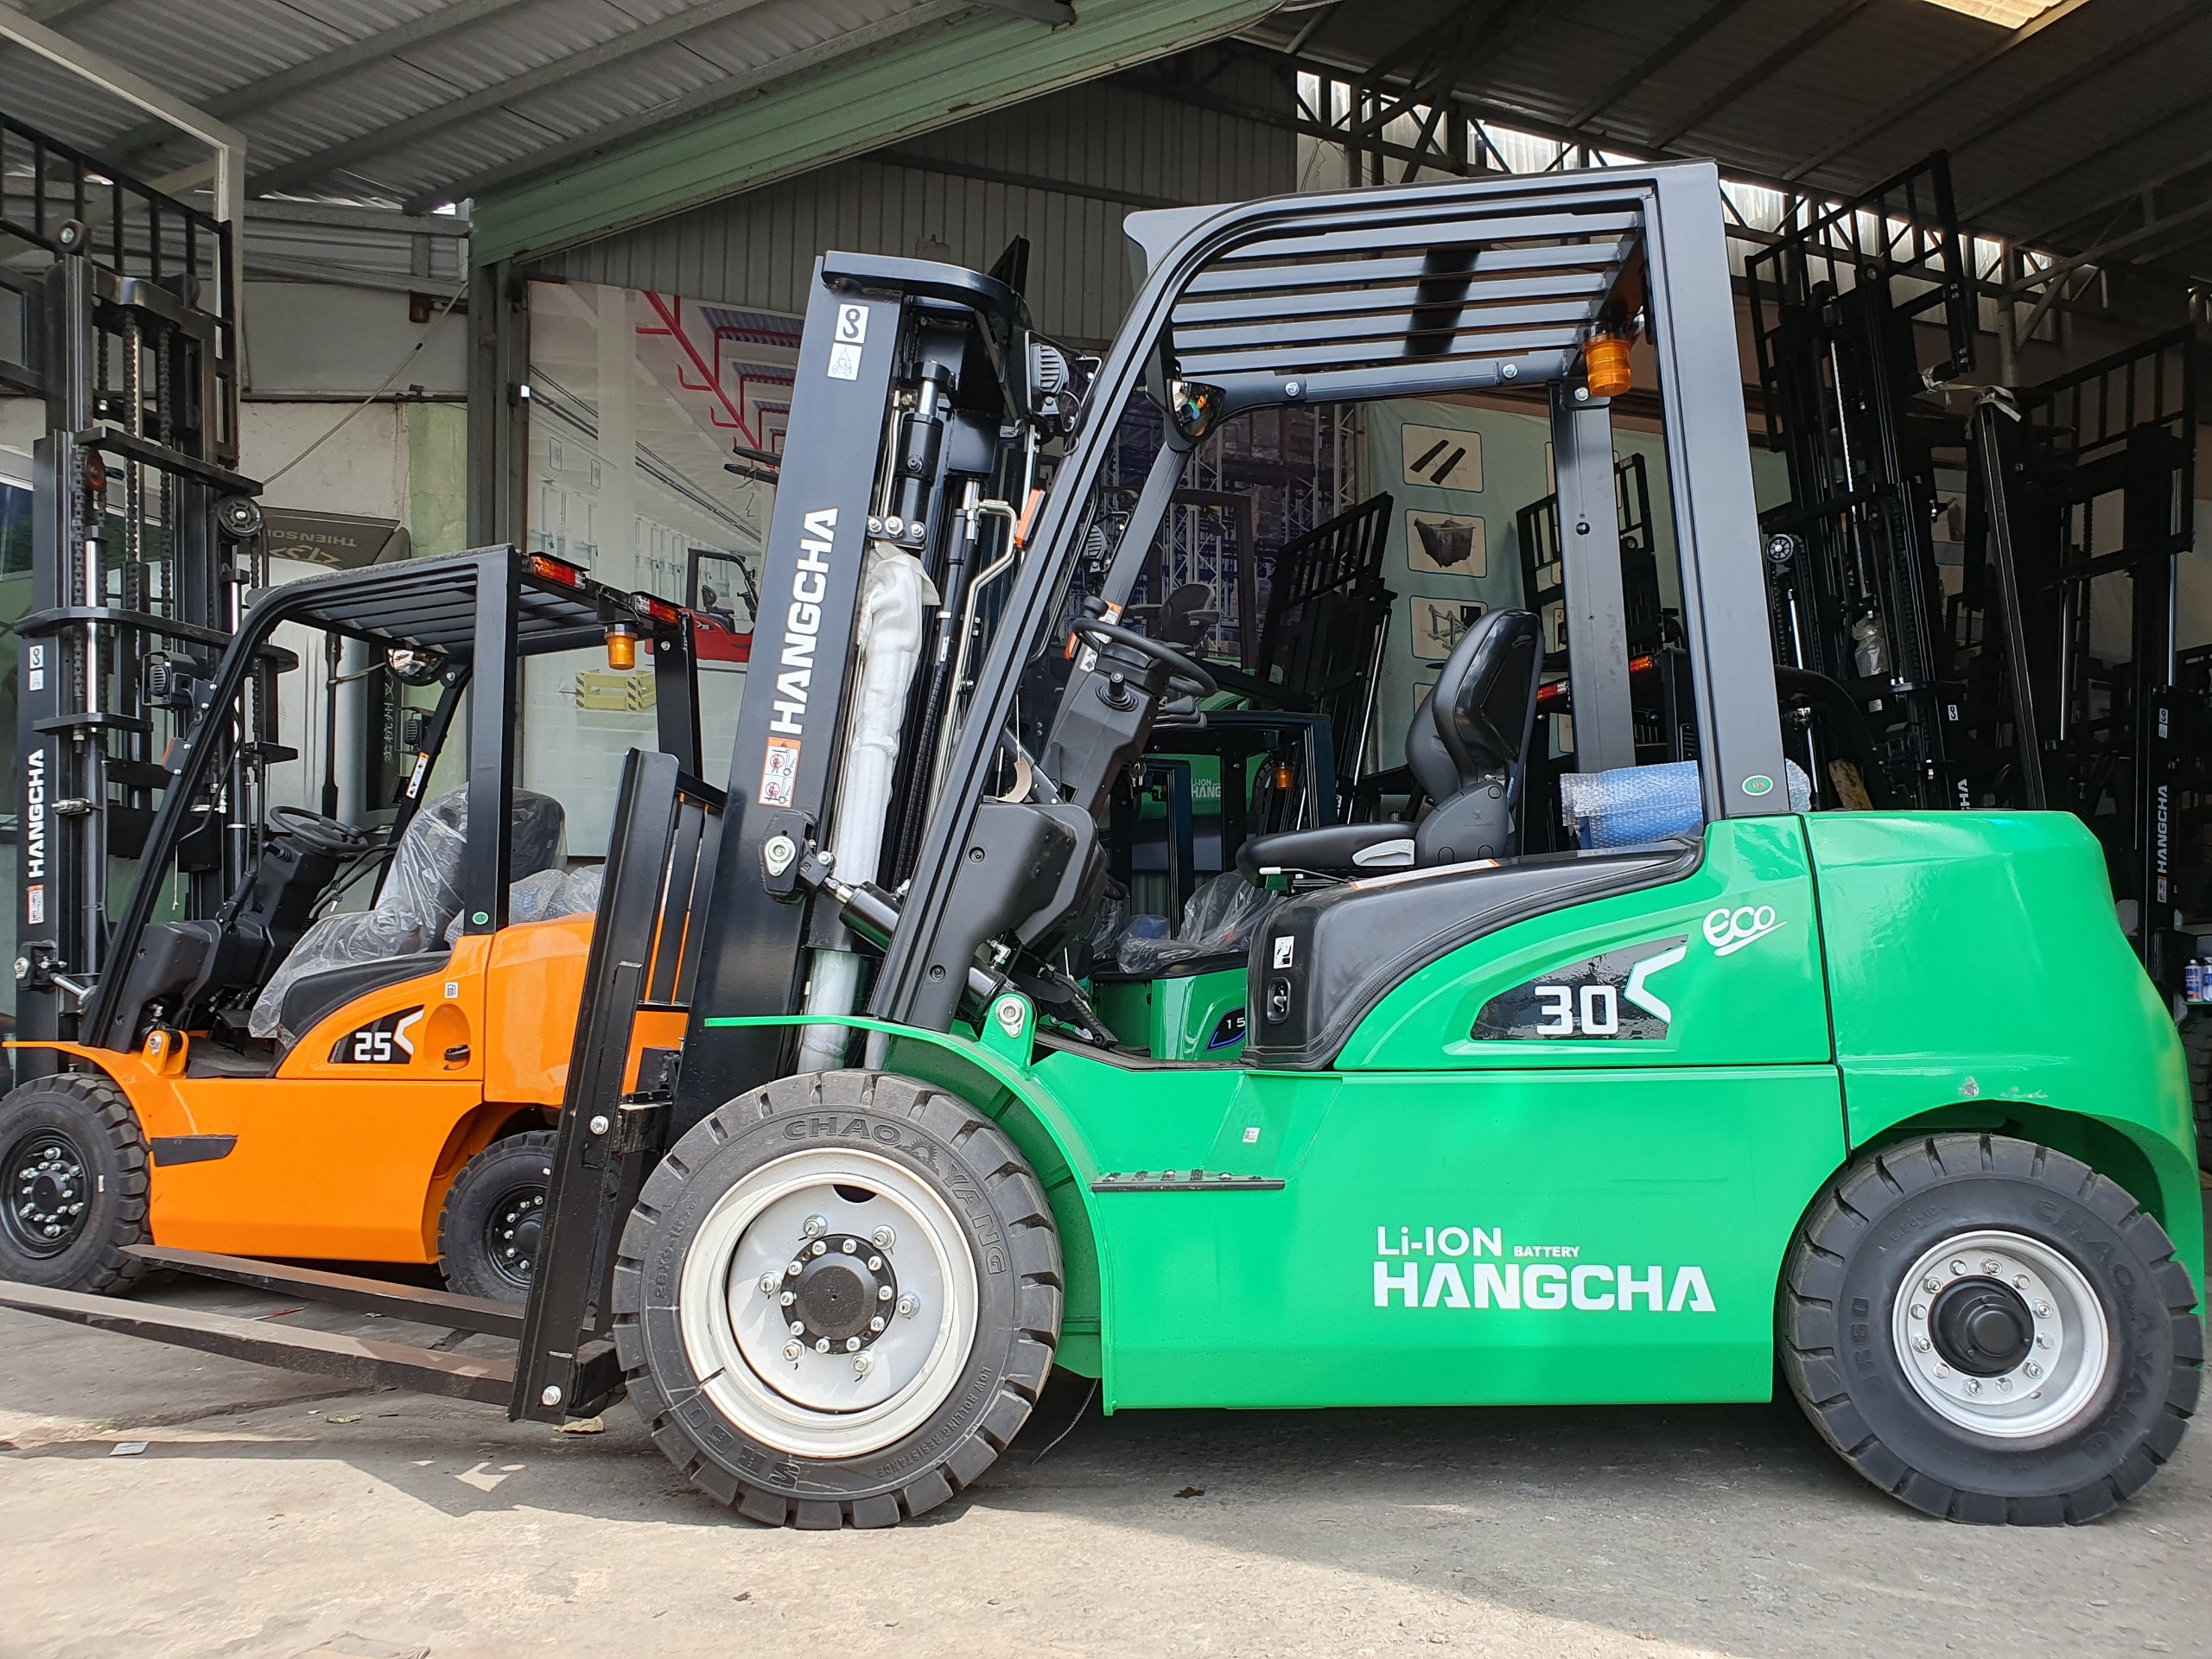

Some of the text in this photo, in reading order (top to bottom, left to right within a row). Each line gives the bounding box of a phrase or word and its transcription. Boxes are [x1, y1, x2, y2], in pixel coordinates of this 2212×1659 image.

[771, 508, 839, 734] HANGCHA
[28, 747, 45, 879] HANGCHA
[2157, 785, 2168, 874] HANGCHA
[1534, 985, 1619, 1035] 30
[354, 1032, 392, 1061] 25
[1376, 1225, 1580, 1258] Li-ION BATTERY
[1373, 1261, 1717, 1313] HANGCHA
[877, 1366, 993, 1478] LOW ROLLING RESISTANCE
